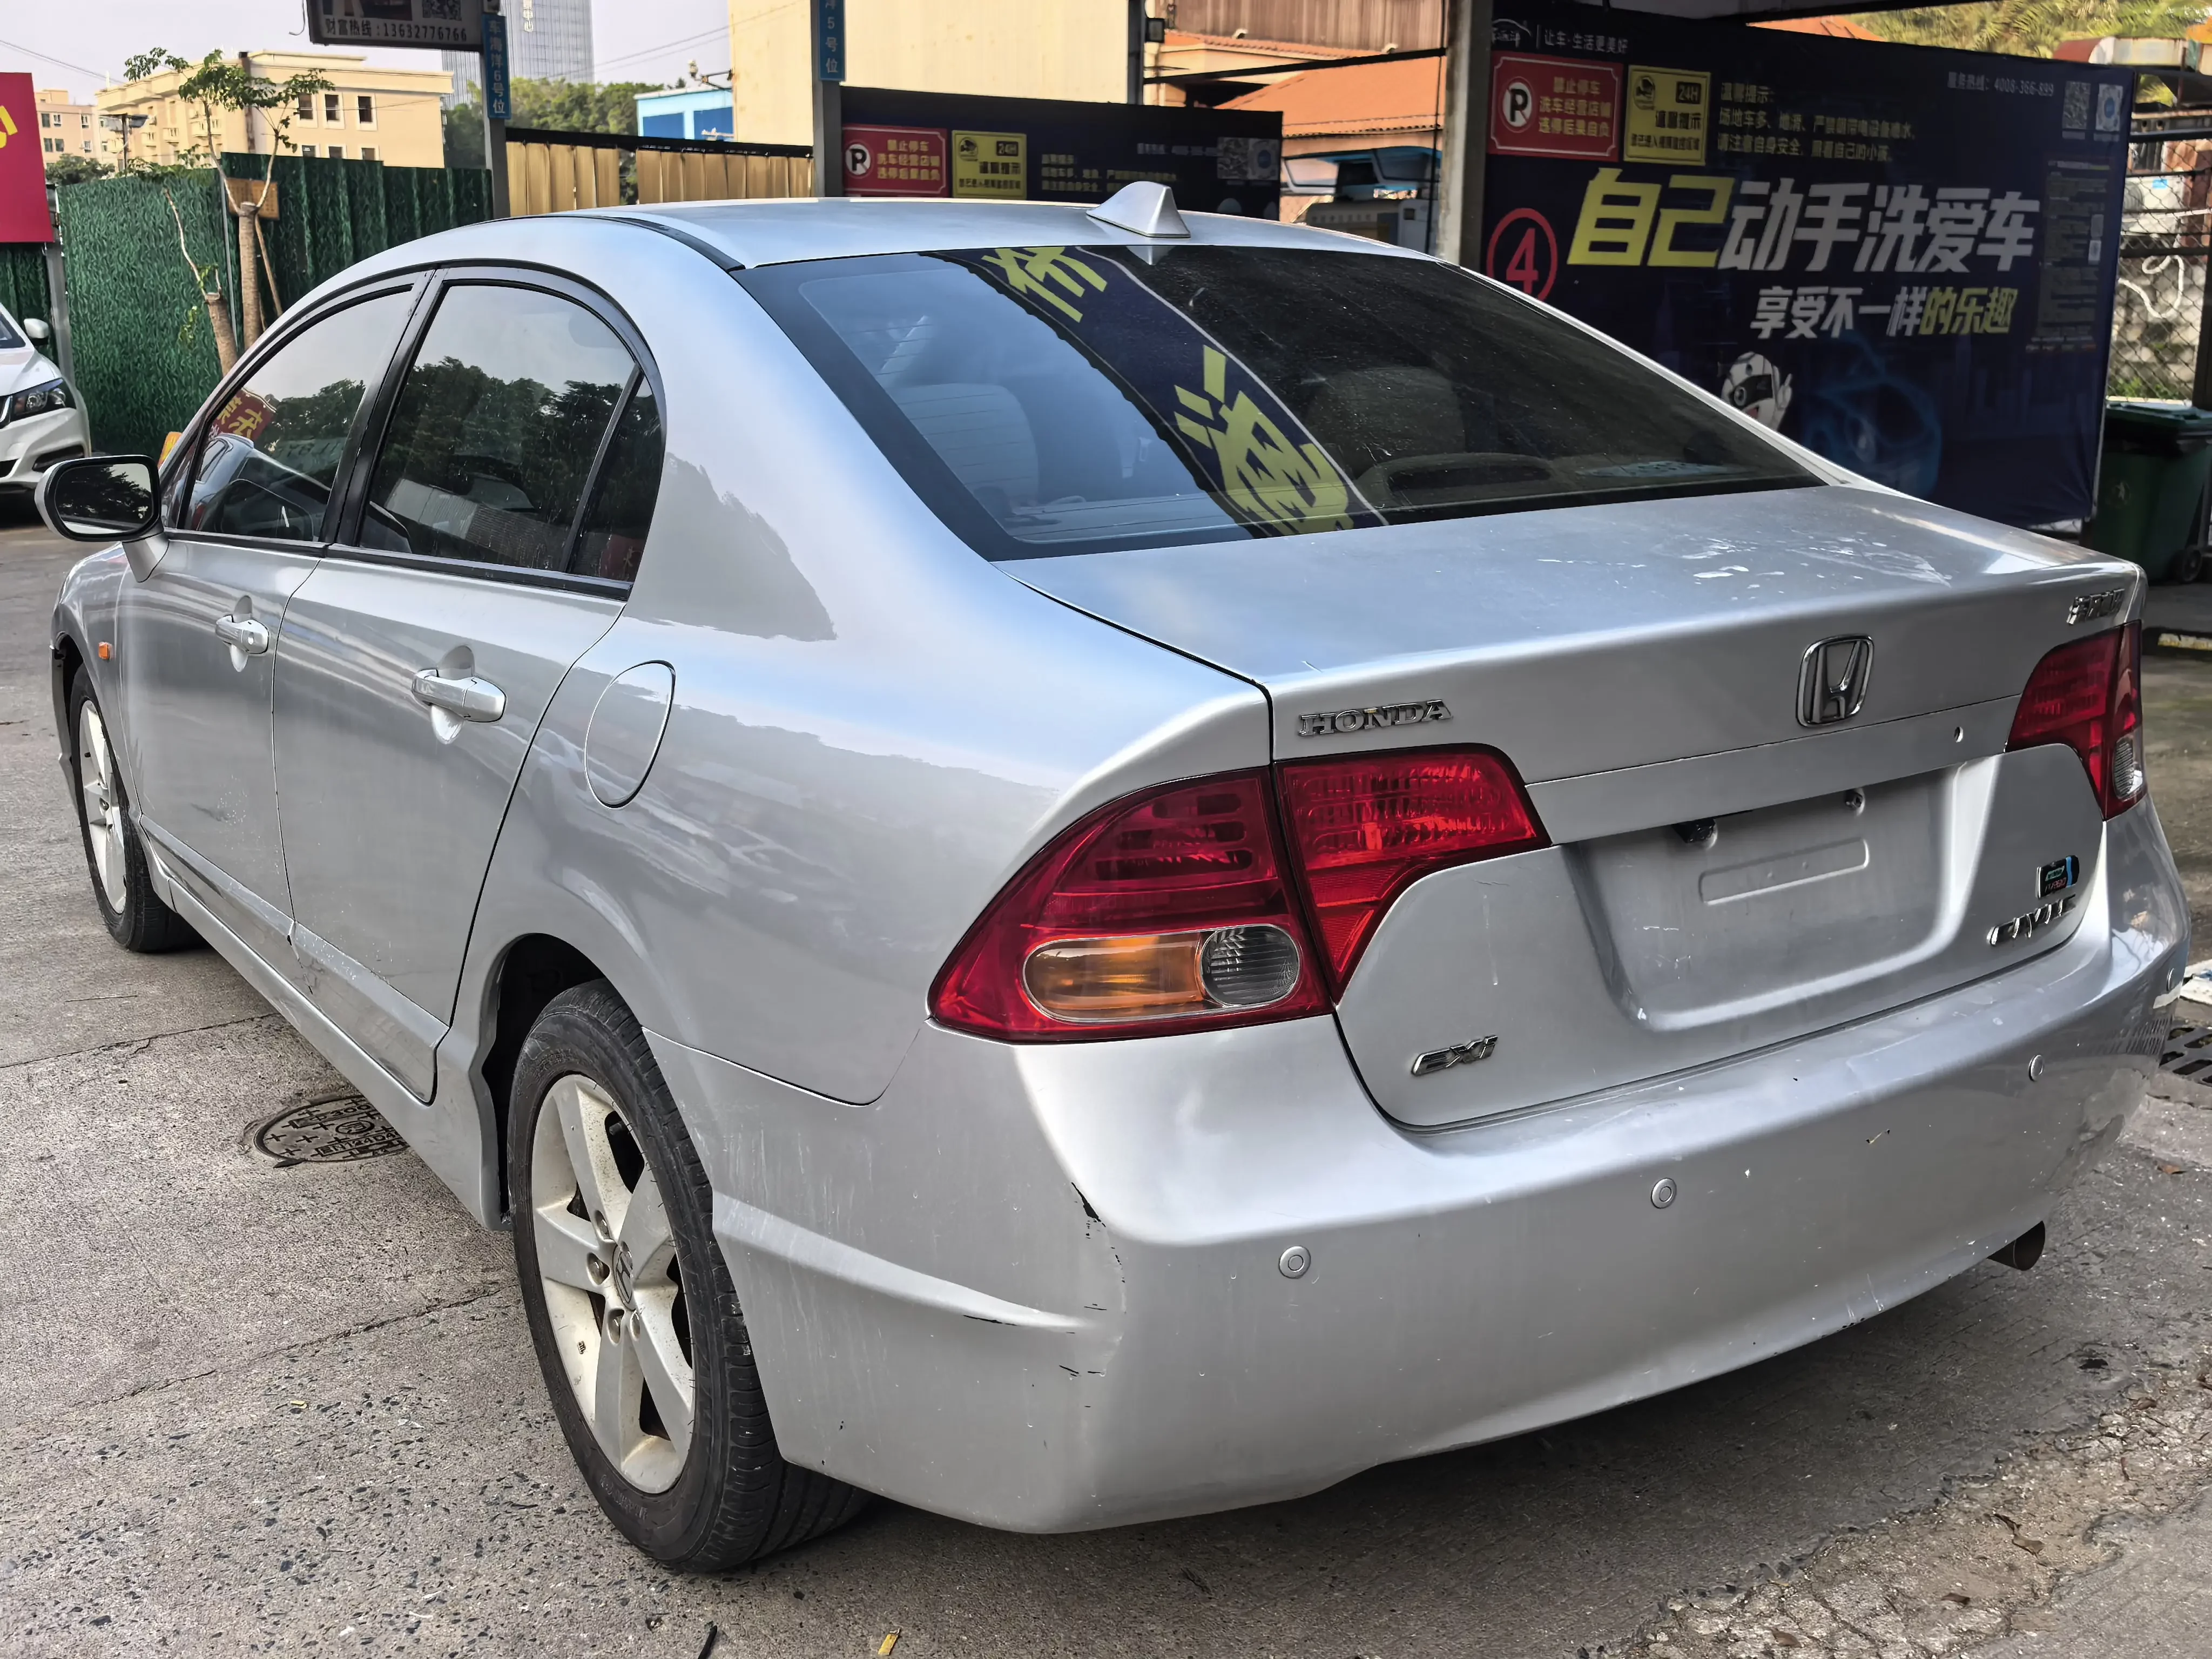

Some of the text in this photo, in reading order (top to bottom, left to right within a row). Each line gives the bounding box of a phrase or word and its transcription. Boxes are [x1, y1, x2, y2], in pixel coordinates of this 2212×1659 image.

[1567, 167, 2040, 272] 自己动手洗爱车
[1750, 286, 2019, 339] 享受不一样的乐趣
[1298, 699, 1454, 736] HONDA
